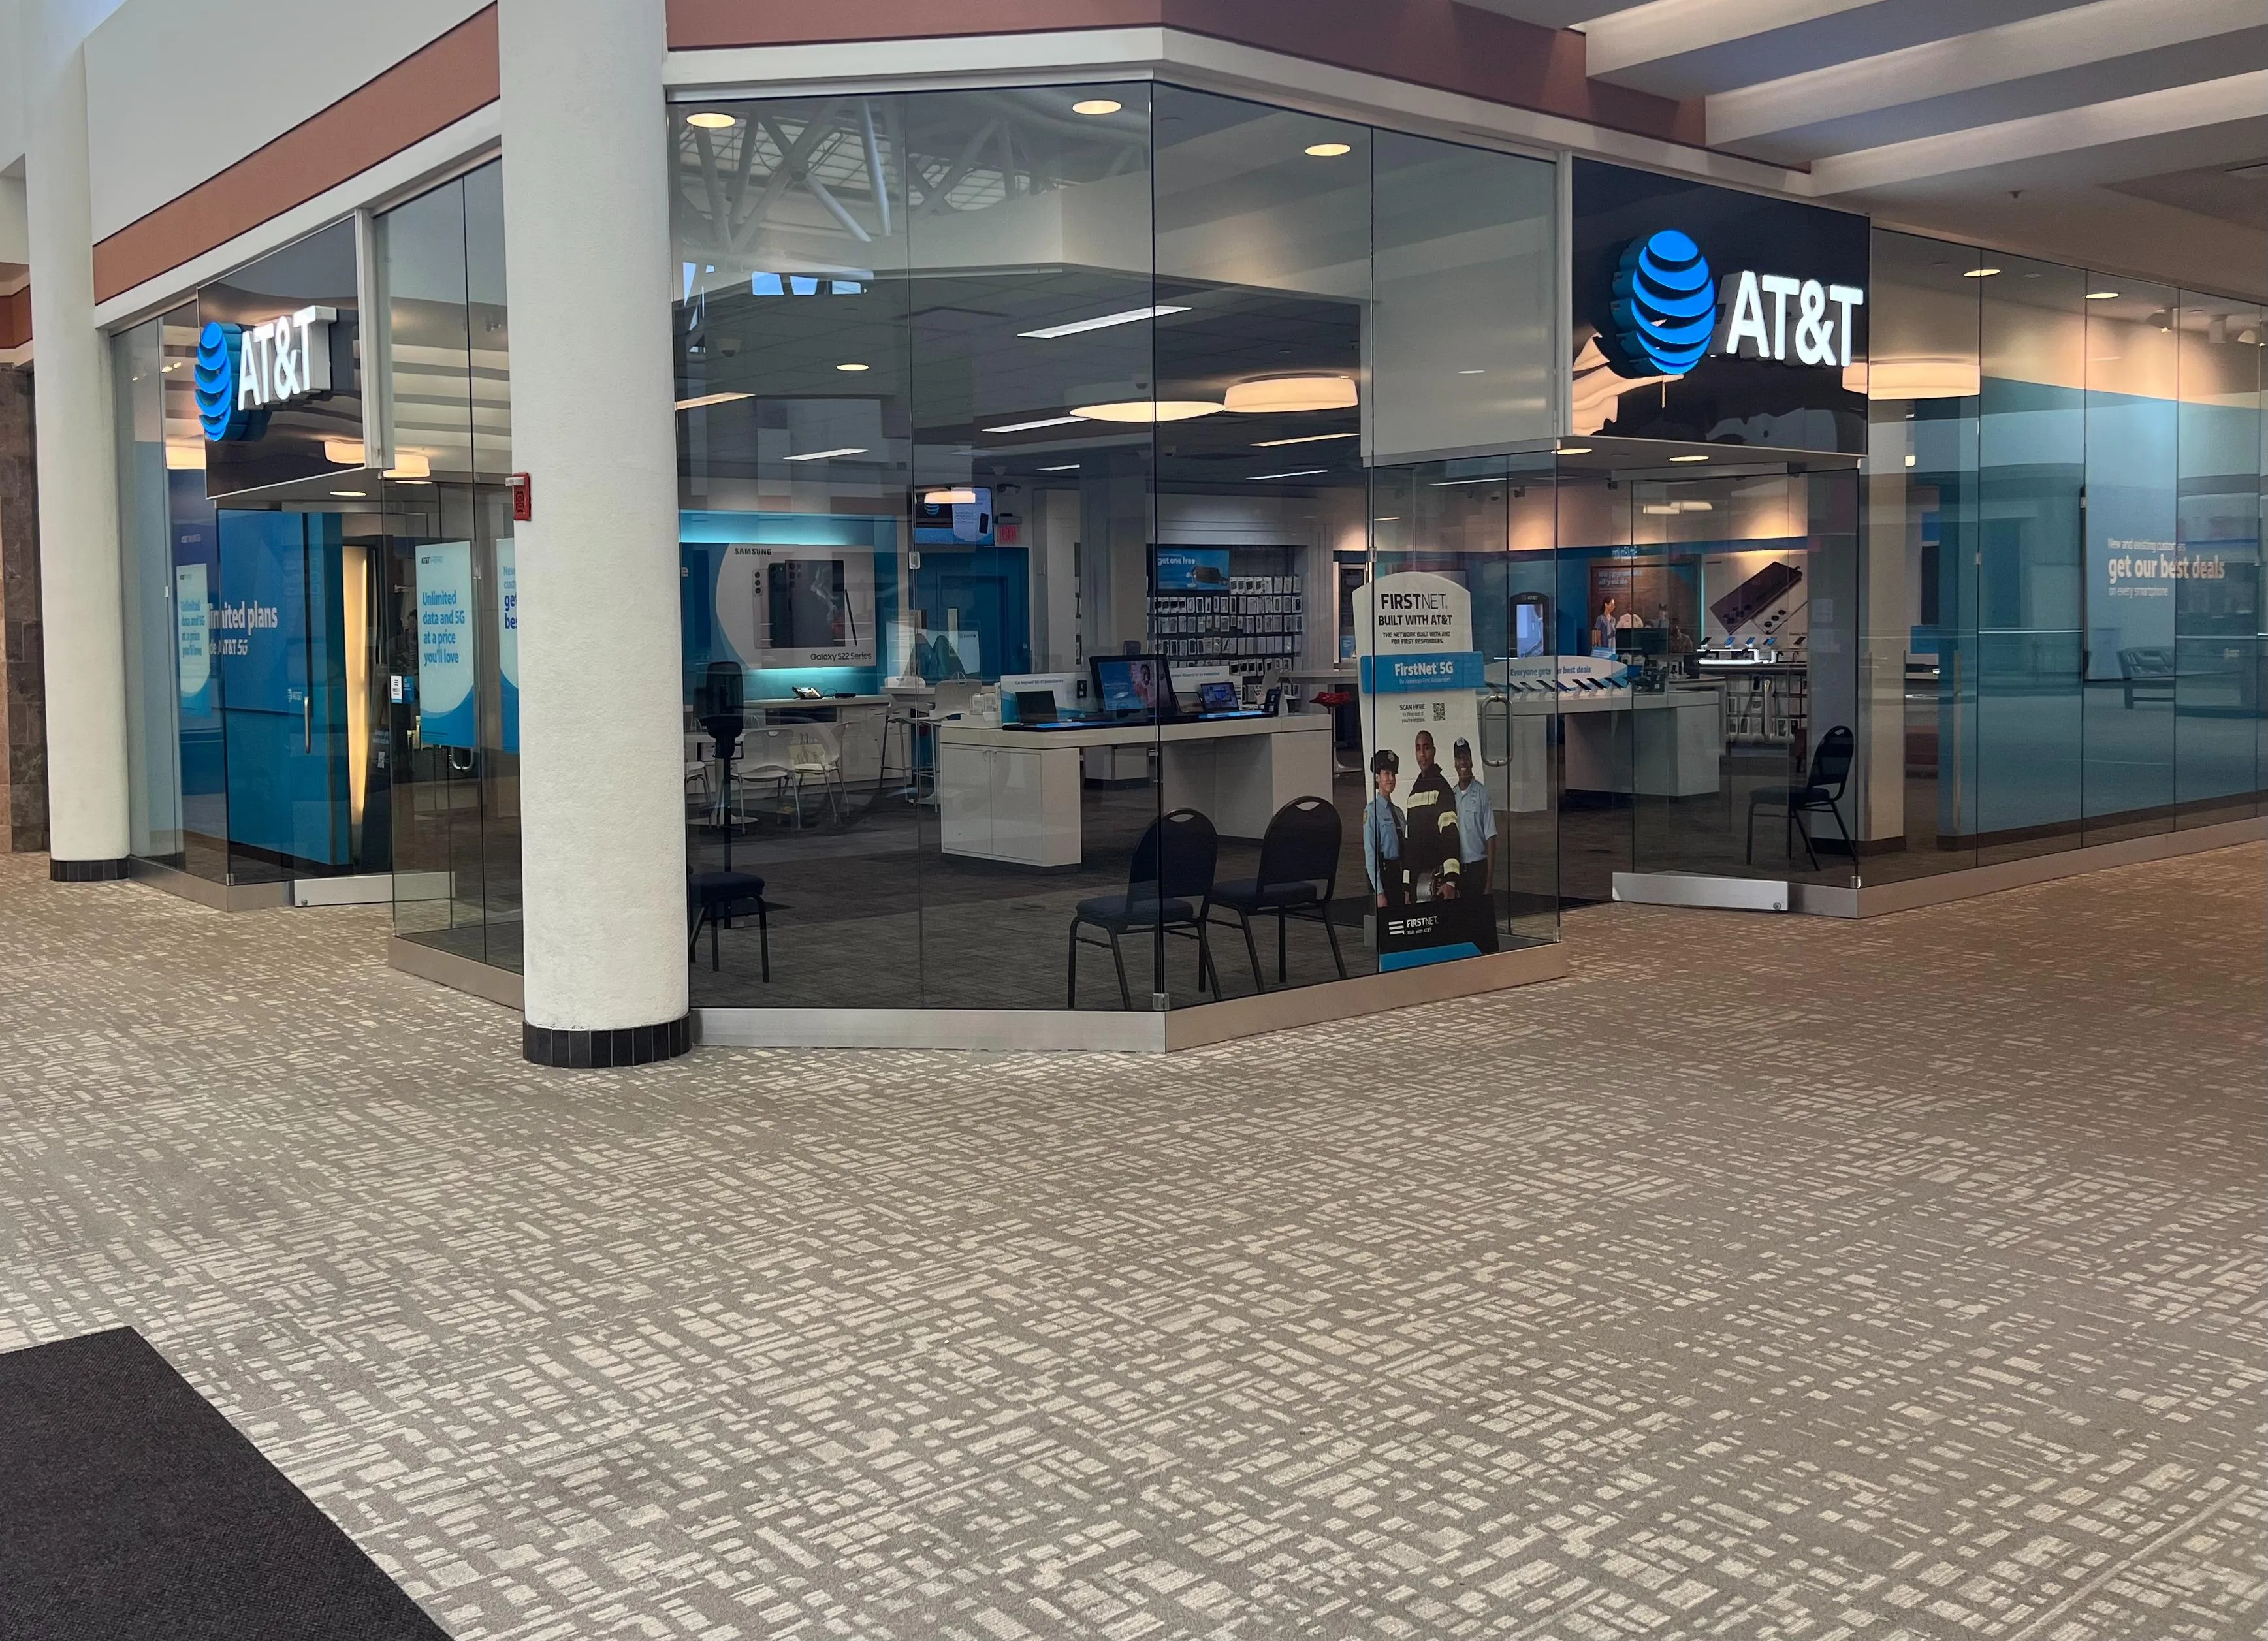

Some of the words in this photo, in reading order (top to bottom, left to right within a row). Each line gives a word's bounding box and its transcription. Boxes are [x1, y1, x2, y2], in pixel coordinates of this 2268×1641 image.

[1726, 270, 1864, 367] AT&T
[238, 305, 318, 411] AT&T
[2108, 555, 2132, 584] get
[2135, 559, 2158, 579] our
[2160, 554, 2190, 579] best
[2192, 555, 2226, 579] deals
[423, 590, 456, 606] Unlimited
[248, 600, 278, 636] plans
[423, 611, 438, 625] data
[440, 610, 453, 624] and
[455, 610, 465, 624] 5G
[1378, 615, 1403, 626] BUILT
[1405, 615, 1428, 626] WITH
[1431, 614, 1452, 625] AT&T
[423, 631, 431, 644] at
[432, 633, 437, 644] a
[438, 629, 456, 648] price
[424, 649, 443, 666] you'll
[444, 649, 459, 664] love
[810, 653, 836, 662] Galaxy
[851, 652, 872, 660] Series
[1439, 661, 1454, 674] 5G
[1510, 669, 1537, 677] Everyone
[1539, 668, 1552, 677] gets
